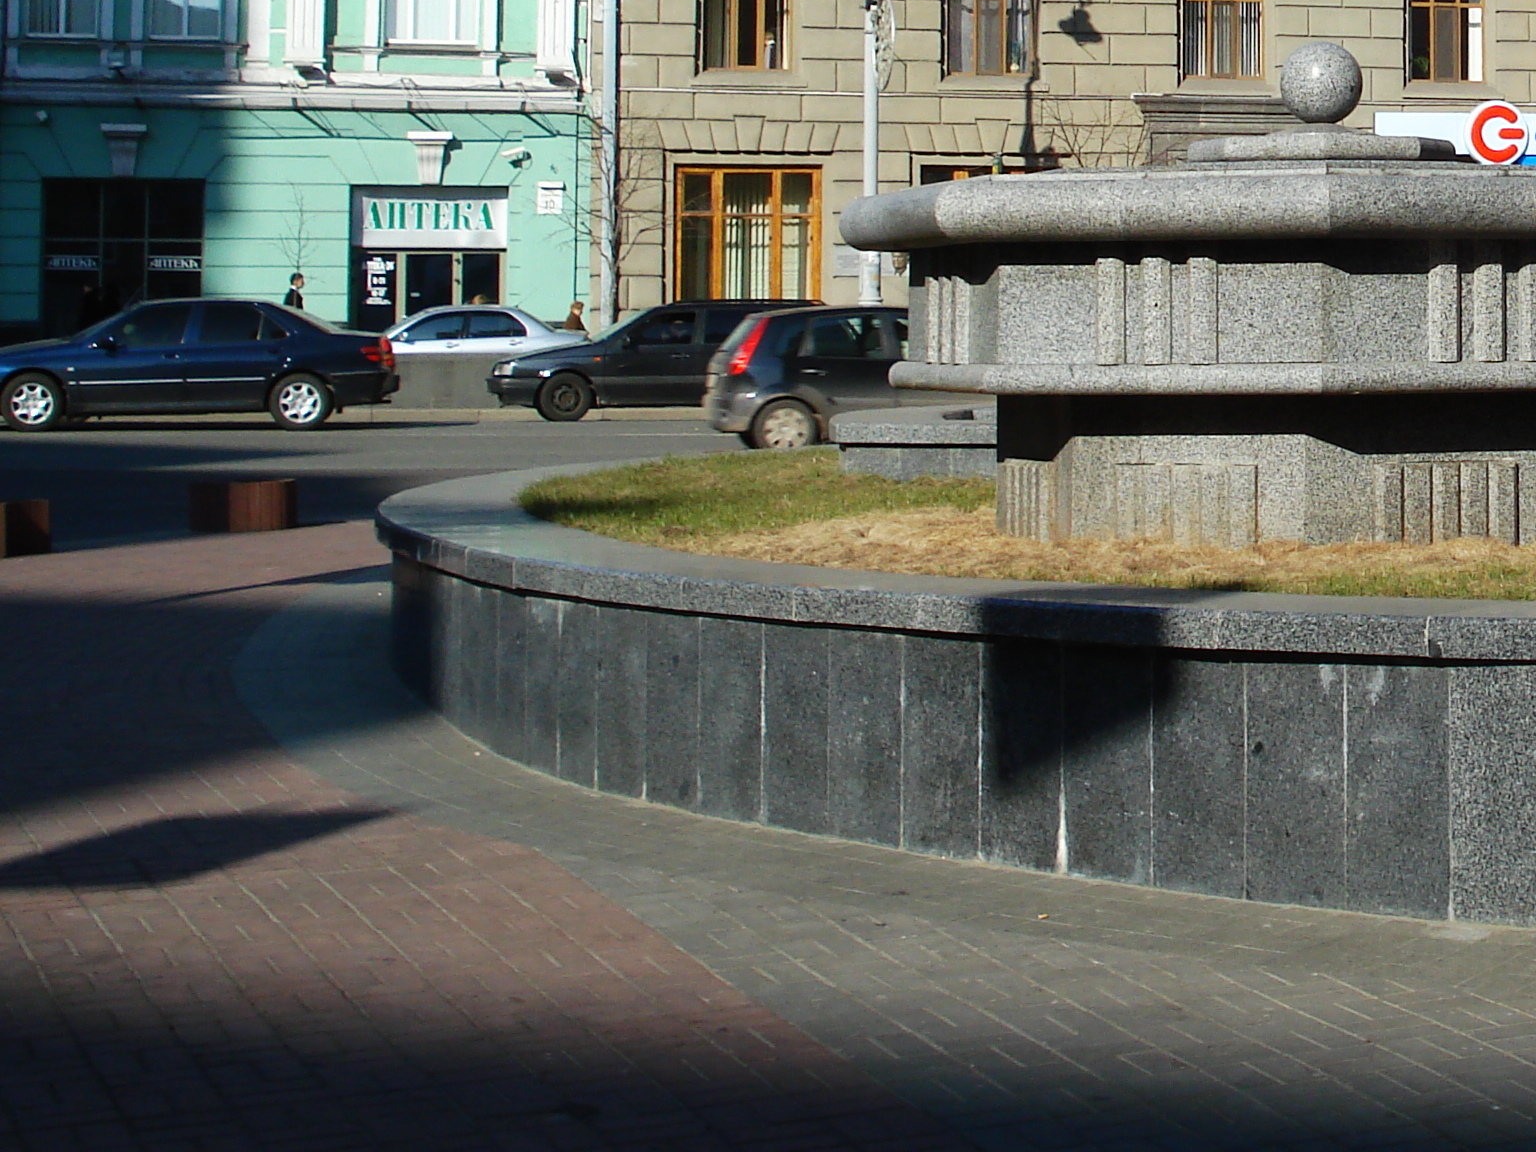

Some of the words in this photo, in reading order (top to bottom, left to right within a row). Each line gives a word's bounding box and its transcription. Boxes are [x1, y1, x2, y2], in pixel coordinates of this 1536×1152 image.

[364, 201, 495, 230] АПТЕКА
[49, 257, 97, 268] АПТЕКА
[151, 258, 199, 269] АПТЕКА
